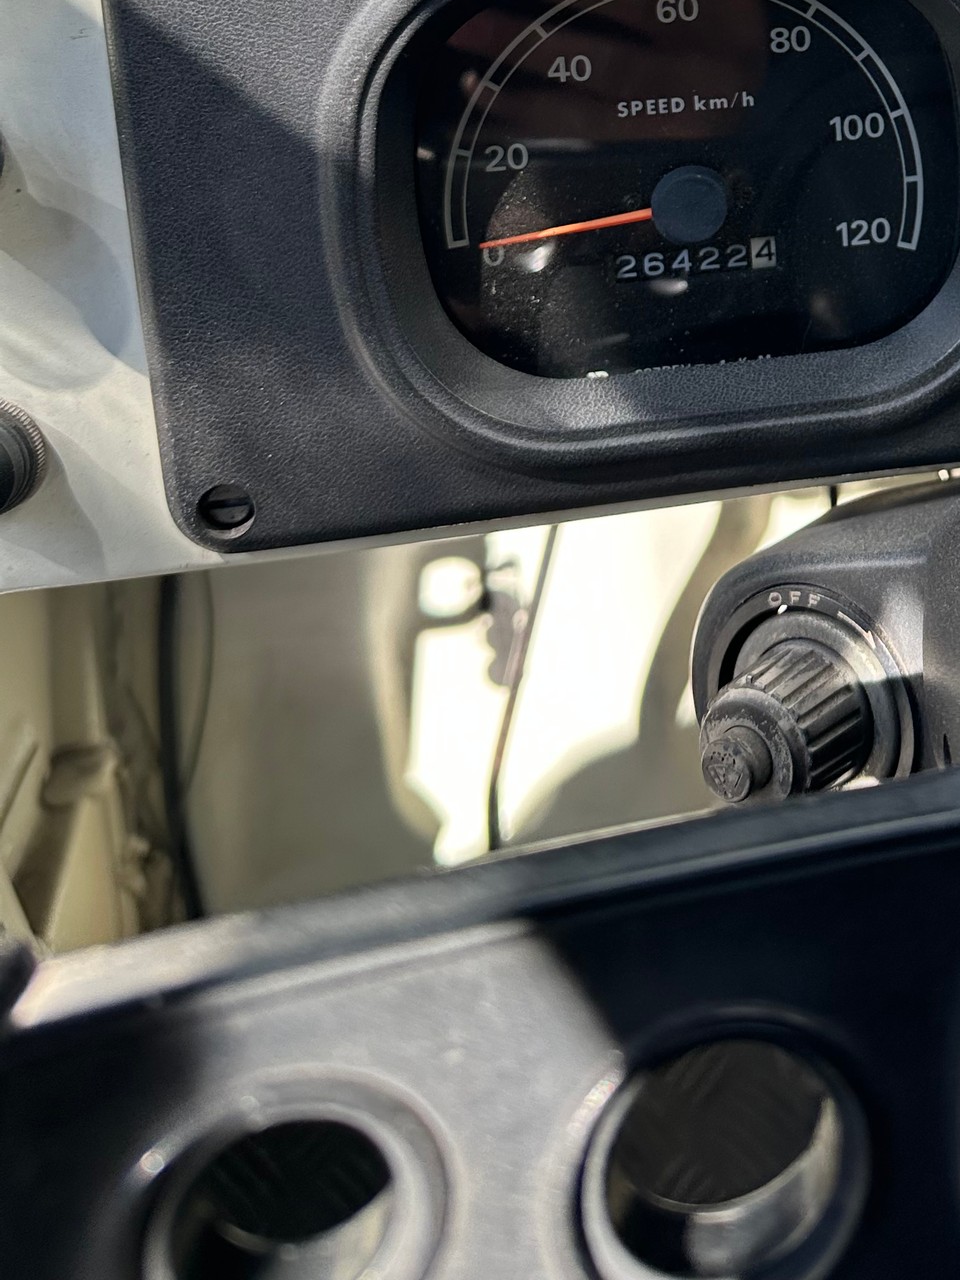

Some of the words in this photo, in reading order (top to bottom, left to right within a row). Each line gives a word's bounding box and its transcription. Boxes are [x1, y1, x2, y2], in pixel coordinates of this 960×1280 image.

[770, 26, 811, 53] 80
[547, 55, 592, 82] 40
[617, 96, 685, 117] SPEED
[694, 91, 755, 111] km/h
[829, 113, 885, 141] 100
[484, 143, 529, 172] 20
[836, 218, 891, 247] 120
[768, 591, 821, 607] OFF
